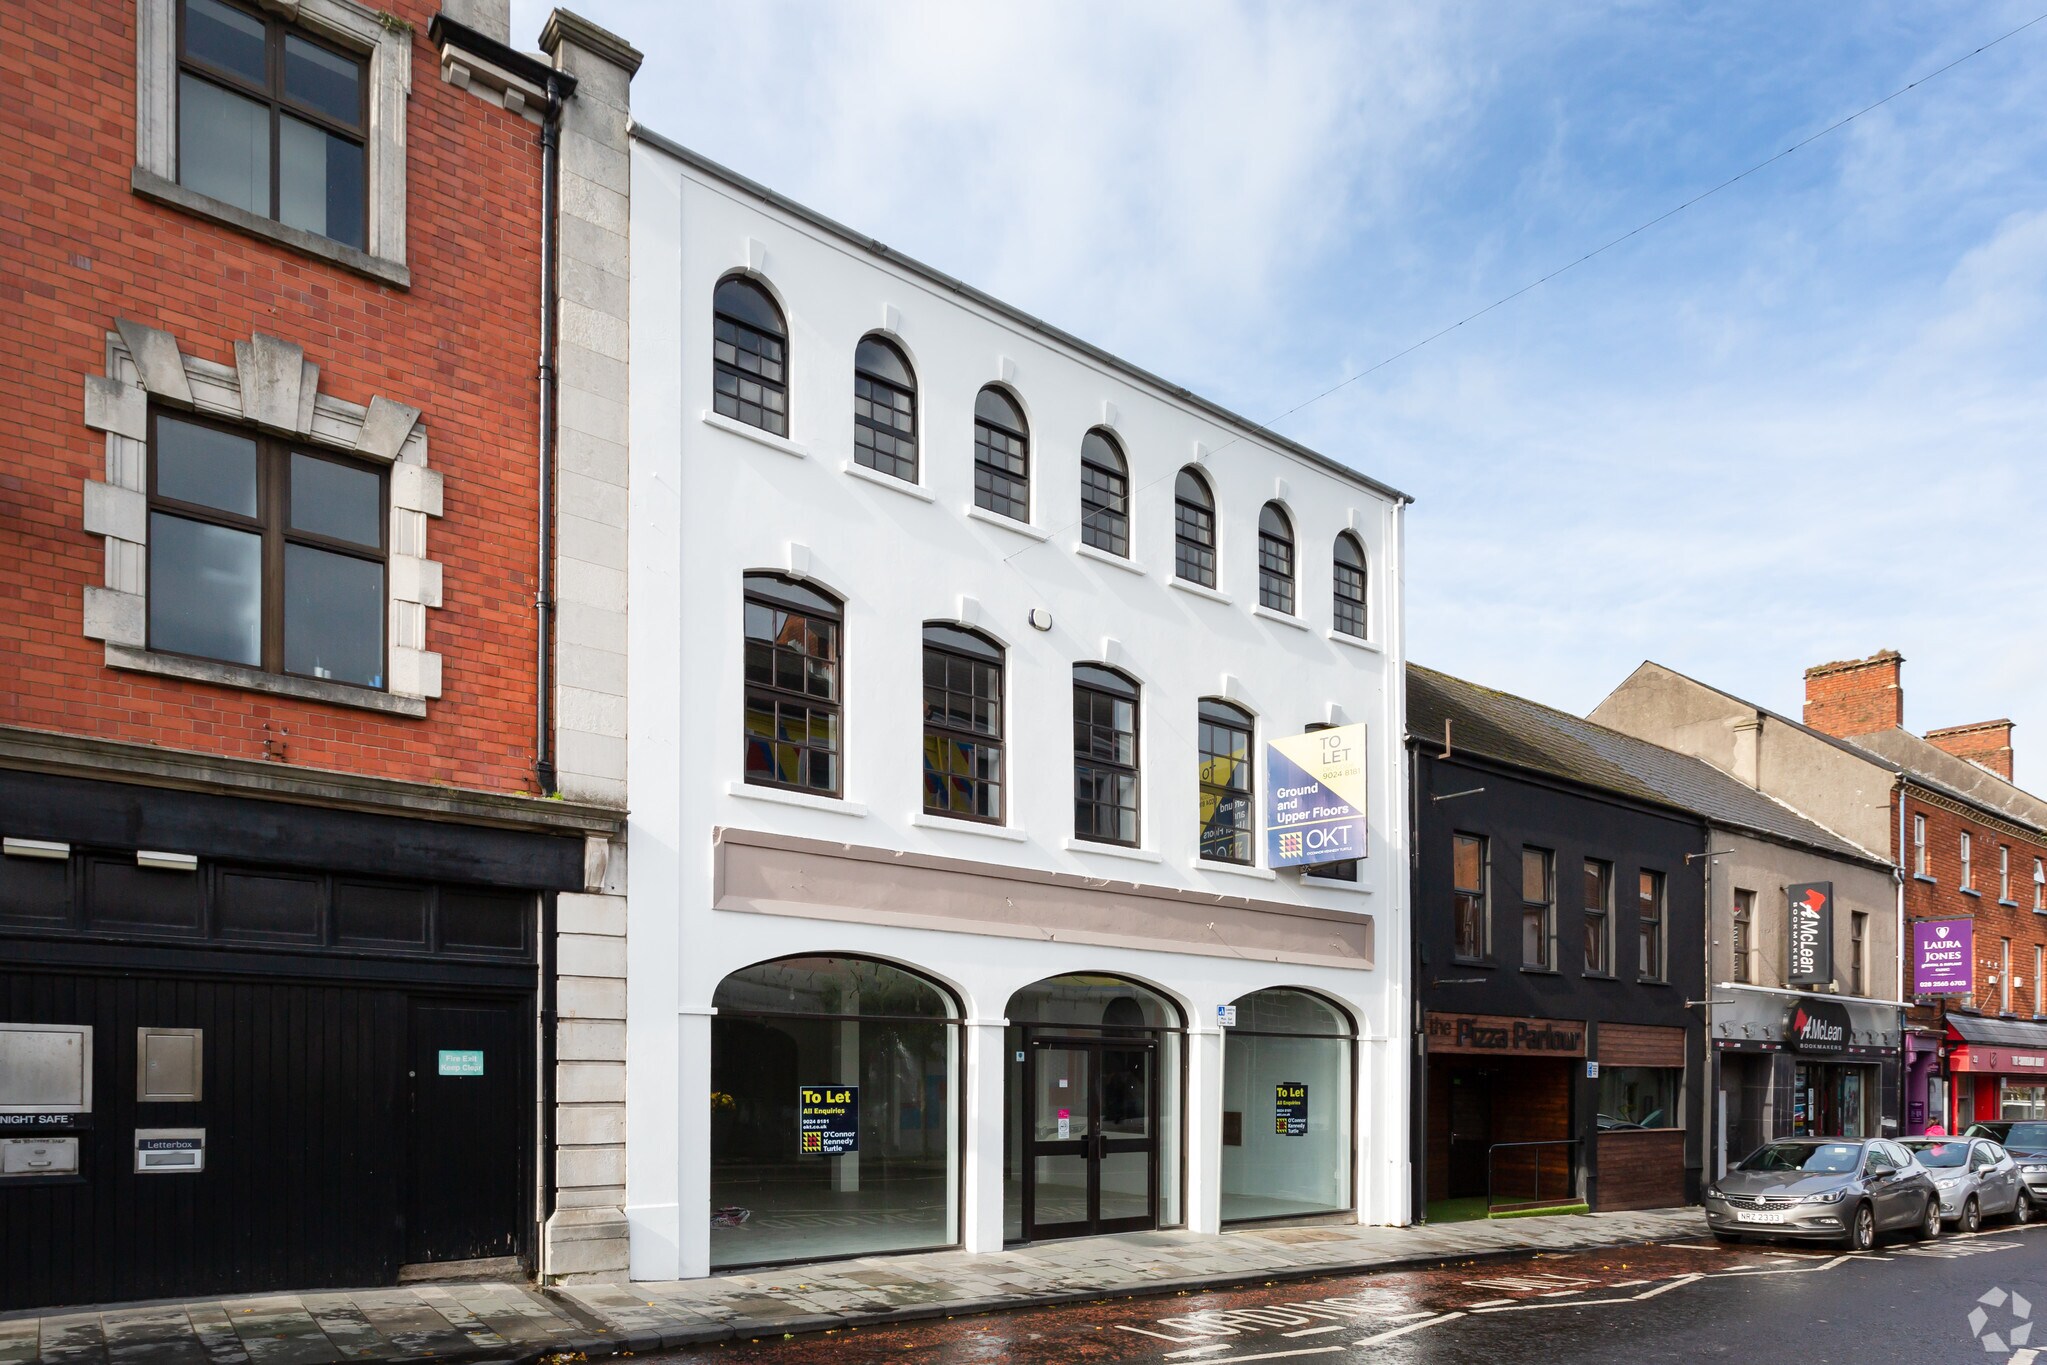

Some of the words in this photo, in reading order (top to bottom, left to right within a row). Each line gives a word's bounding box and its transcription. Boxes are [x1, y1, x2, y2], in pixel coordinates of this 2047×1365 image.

[1320, 735, 1341, 750] TO
[1322, 748, 1352, 765] LET
[1322, 770, 1343, 780] 9024
[1277, 782, 1319, 799] Ground
[1277, 798, 1298, 811] and
[1277, 810, 1311, 825] Upper
[1312, 805, 1349, 819] Floors
[1306, 825, 1353, 849] OKT
[1799, 901, 1821, 974] A.McLean
[1923, 940, 1962, 950] LAURA
[1925, 951, 1962, 963] JONES
[1429, 1017, 1452, 1036] the
[1457, 1018, 1509, 1049] Pizza
[1513, 1021, 1582, 1051] Parlour
[1801, 1015, 1843, 1042] A.McLean
[1799, 1042, 1843, 1051] BOOKMAKERS
[442, 1064, 460, 1072] Keep
[462, 1064, 481, 1072] Clear
[802, 1090, 822, 1104] To
[826, 1090, 851, 1104] Let
[1277, 1087, 1288, 1098] To
[1290, 1087, 1304, 1098] Let
[0, 1115, 36, 1125] NIGHT
[38, 1115, 69, 1124] SAFE
[147, 1140, 193, 1149] Letterbox
[823, 1138, 854, 1146] Kennedy
[1758, 1213, 1780, 1222] 2333
[1114, 1297, 1404, 1343] LOADING
